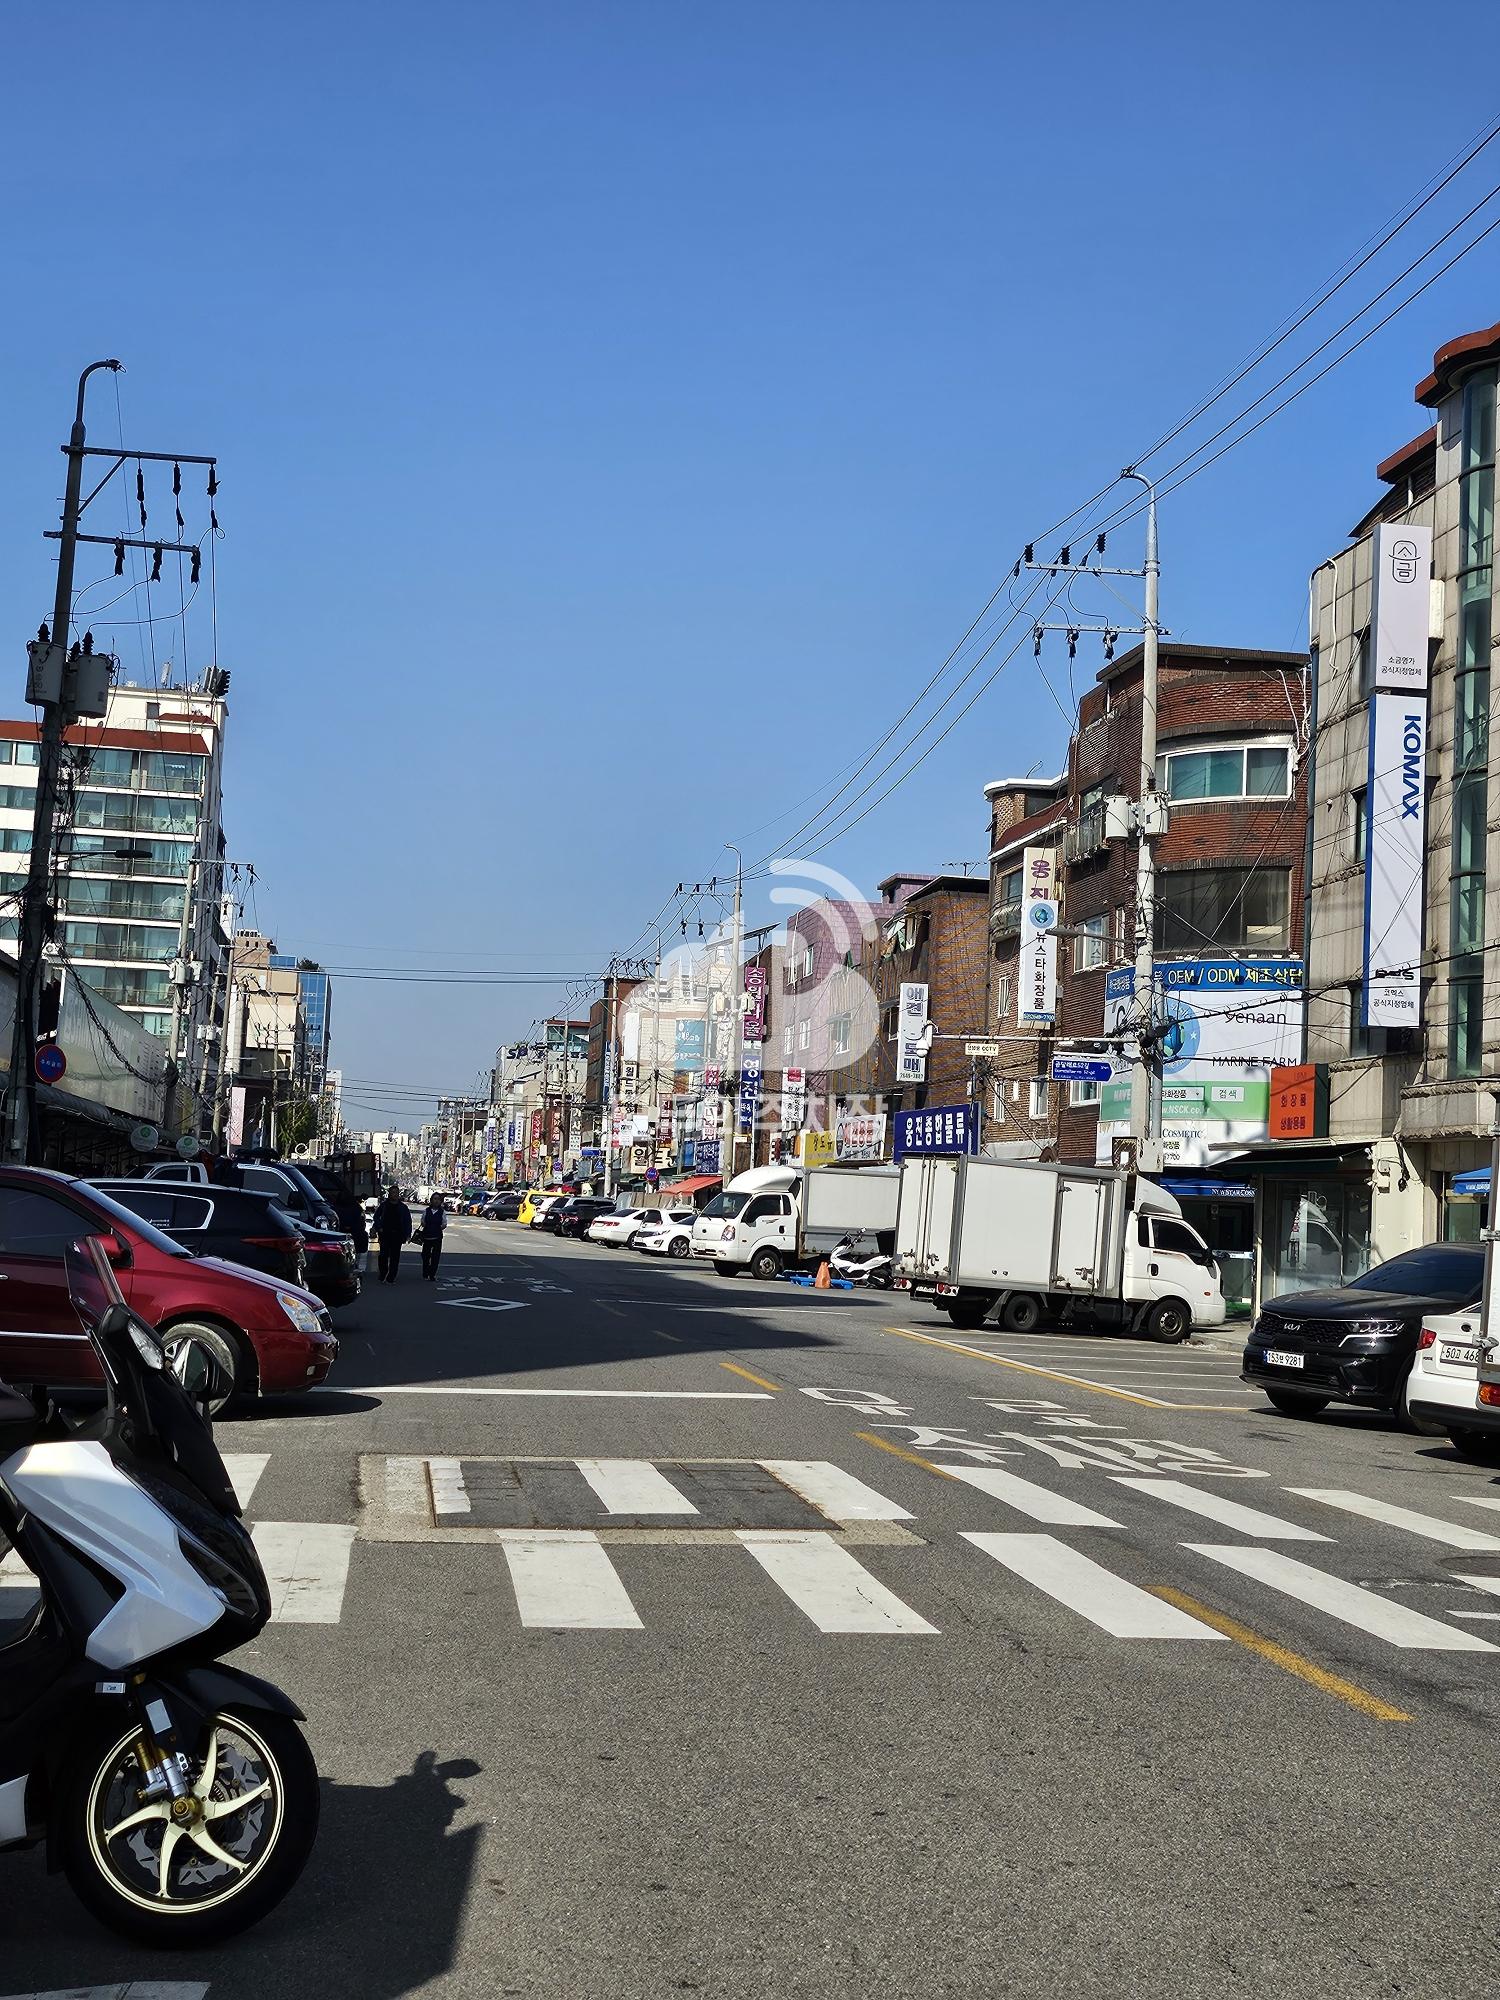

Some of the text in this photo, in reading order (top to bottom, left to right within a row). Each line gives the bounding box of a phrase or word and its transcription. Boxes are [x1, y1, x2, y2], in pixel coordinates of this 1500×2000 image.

[1401, 714, 1422, 821] KOMAX
[1168, 968, 1195, 985] OEM
[1207, 967, 1240, 984] ODM
[1212, 1056, 1297, 1068] MARINE FARM
